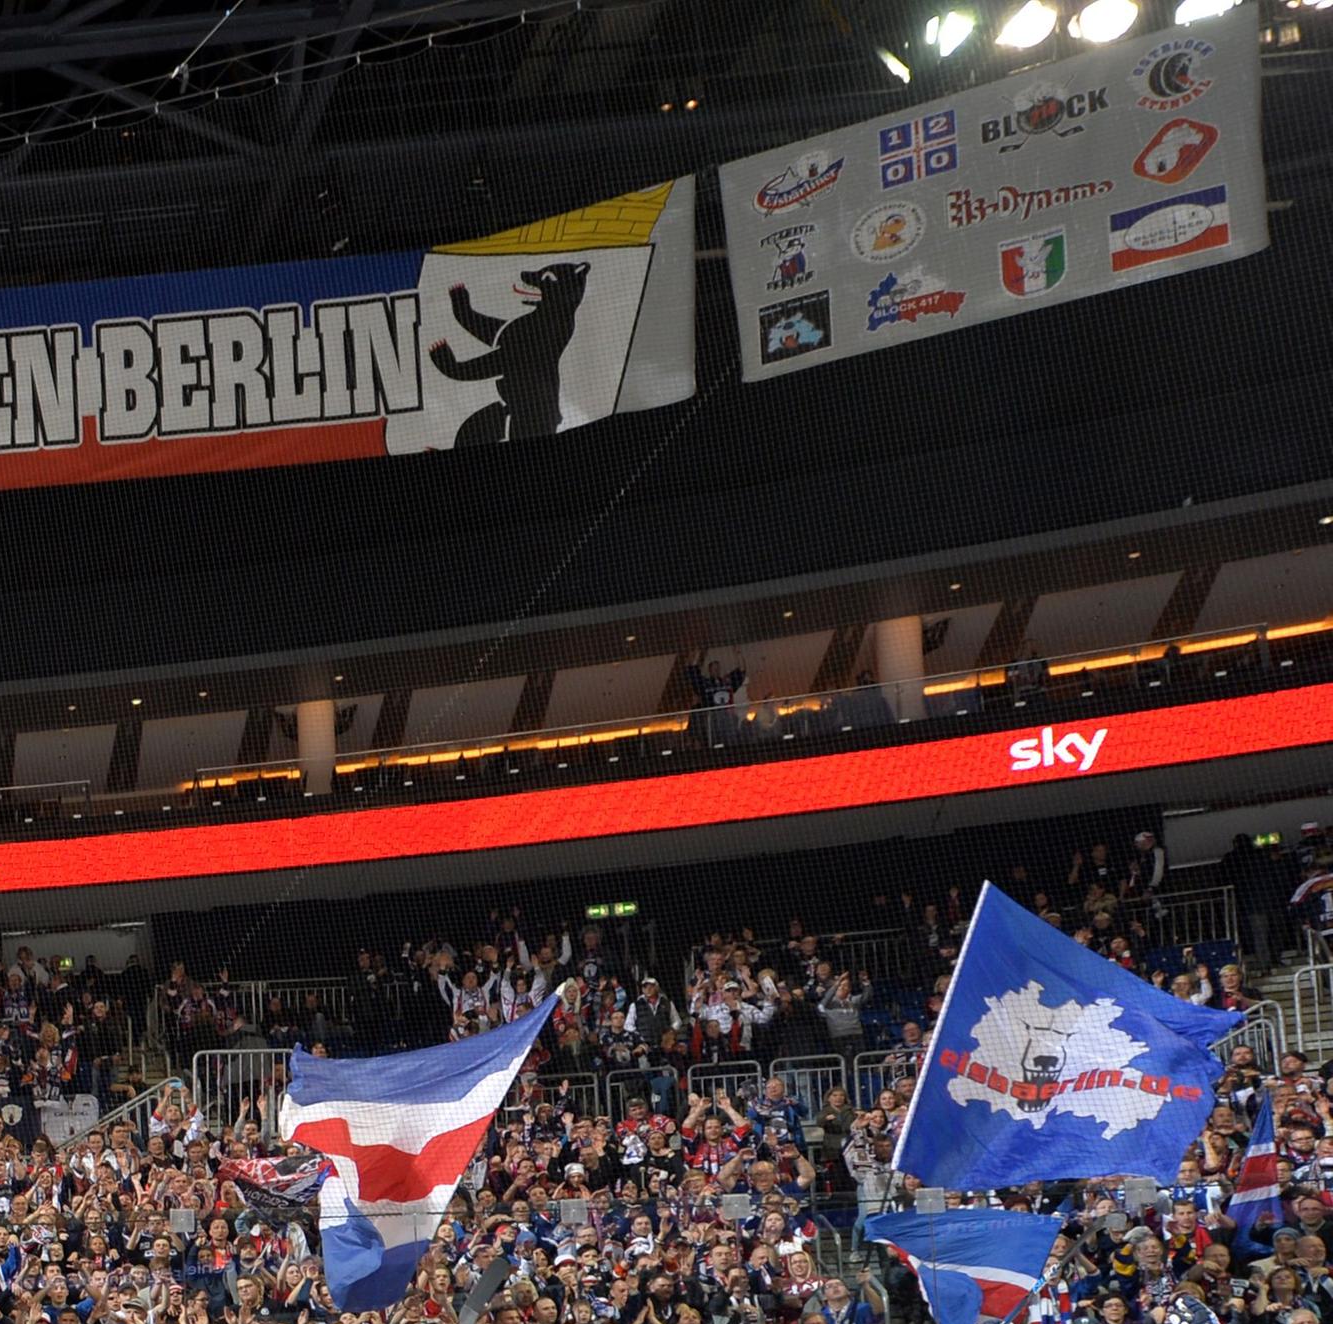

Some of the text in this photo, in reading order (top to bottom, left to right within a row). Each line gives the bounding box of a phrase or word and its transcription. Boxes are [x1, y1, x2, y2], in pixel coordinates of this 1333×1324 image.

[981, 86, 1110, 145] BLOCK
[873, 301, 918, 320] BLOCK
[93, 290, 425, 445] BERLIN
[1009, 726, 1109, 772] sky
